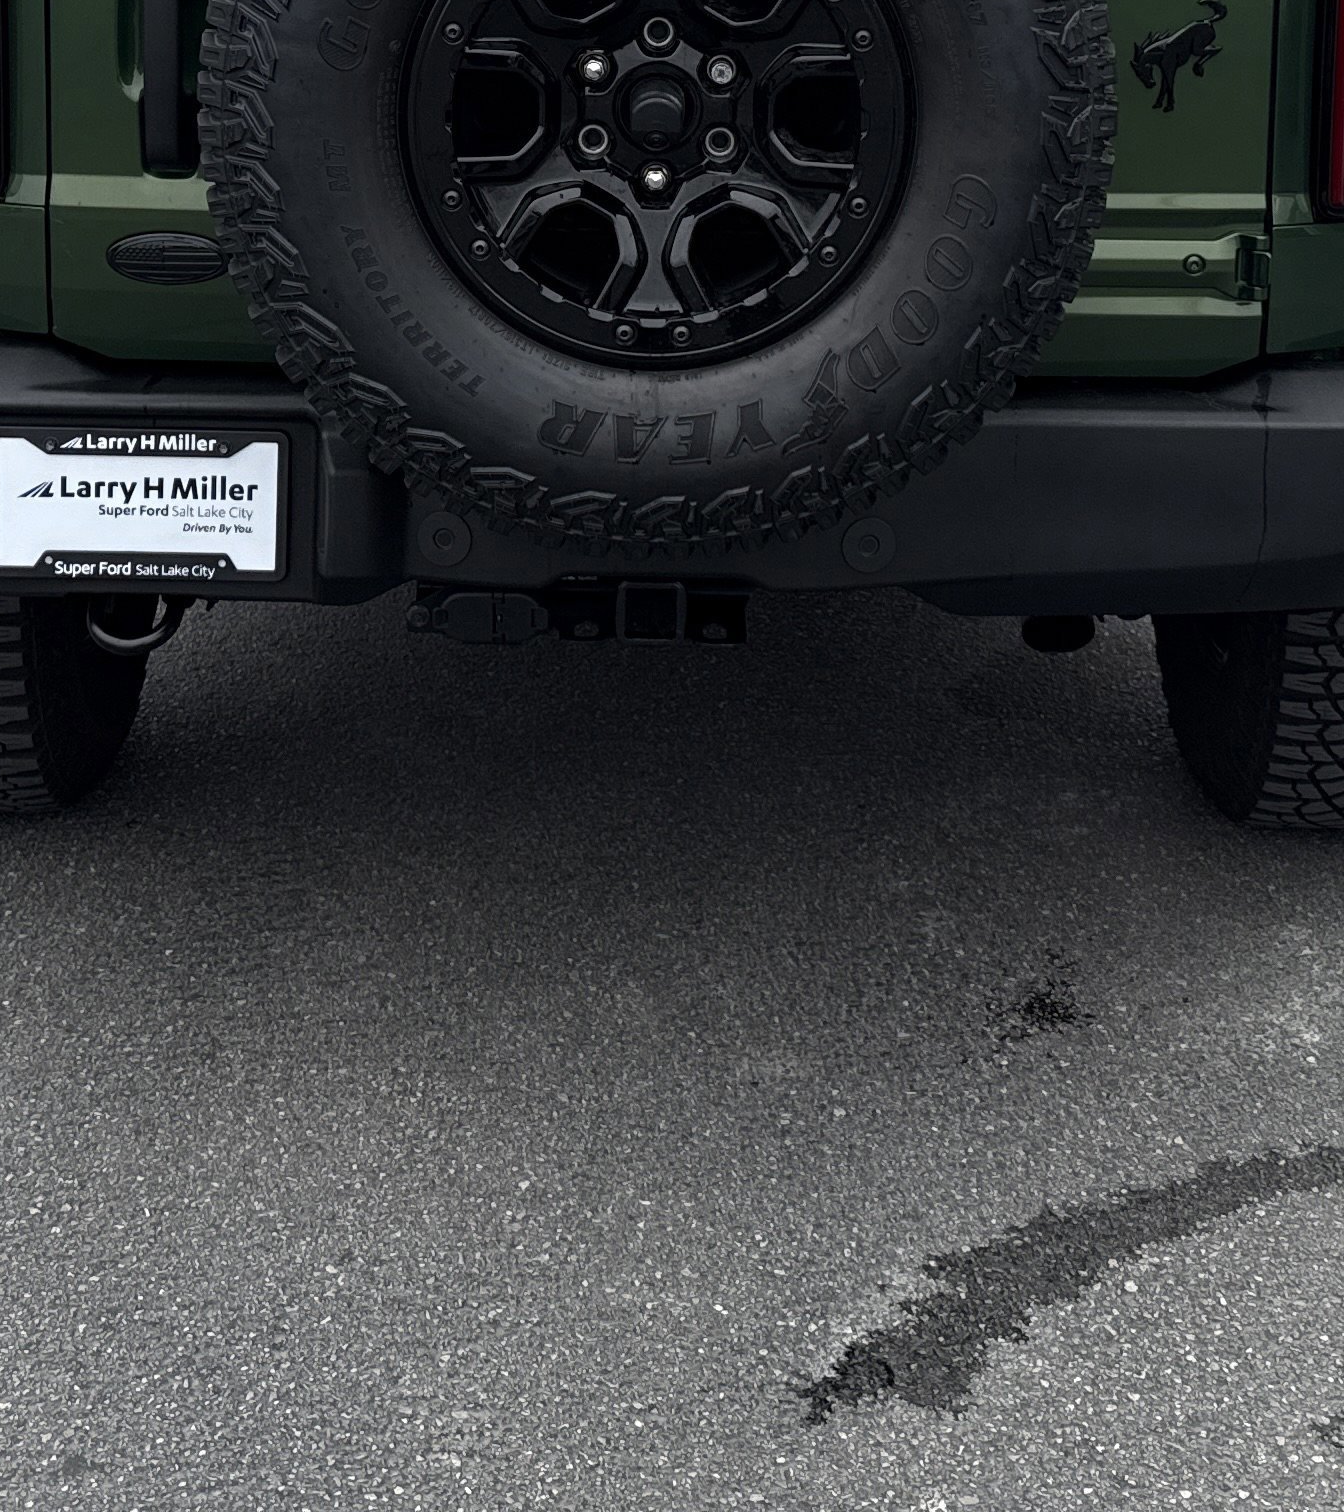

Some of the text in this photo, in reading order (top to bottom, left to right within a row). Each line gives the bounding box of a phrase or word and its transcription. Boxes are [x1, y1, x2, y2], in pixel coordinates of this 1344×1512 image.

[323, 139, 351, 192] MT
[340, 225, 486, 397] TERRITORY
[86, 434, 216, 453] Larry H Miller
[60, 476, 258, 504] Larry H Miller
[98, 504, 253, 522] Super Ford Salt Lake City
[183, 523, 253, 535] Driven By You
[54, 561, 215, 579] Super Ford Salt Lake City
